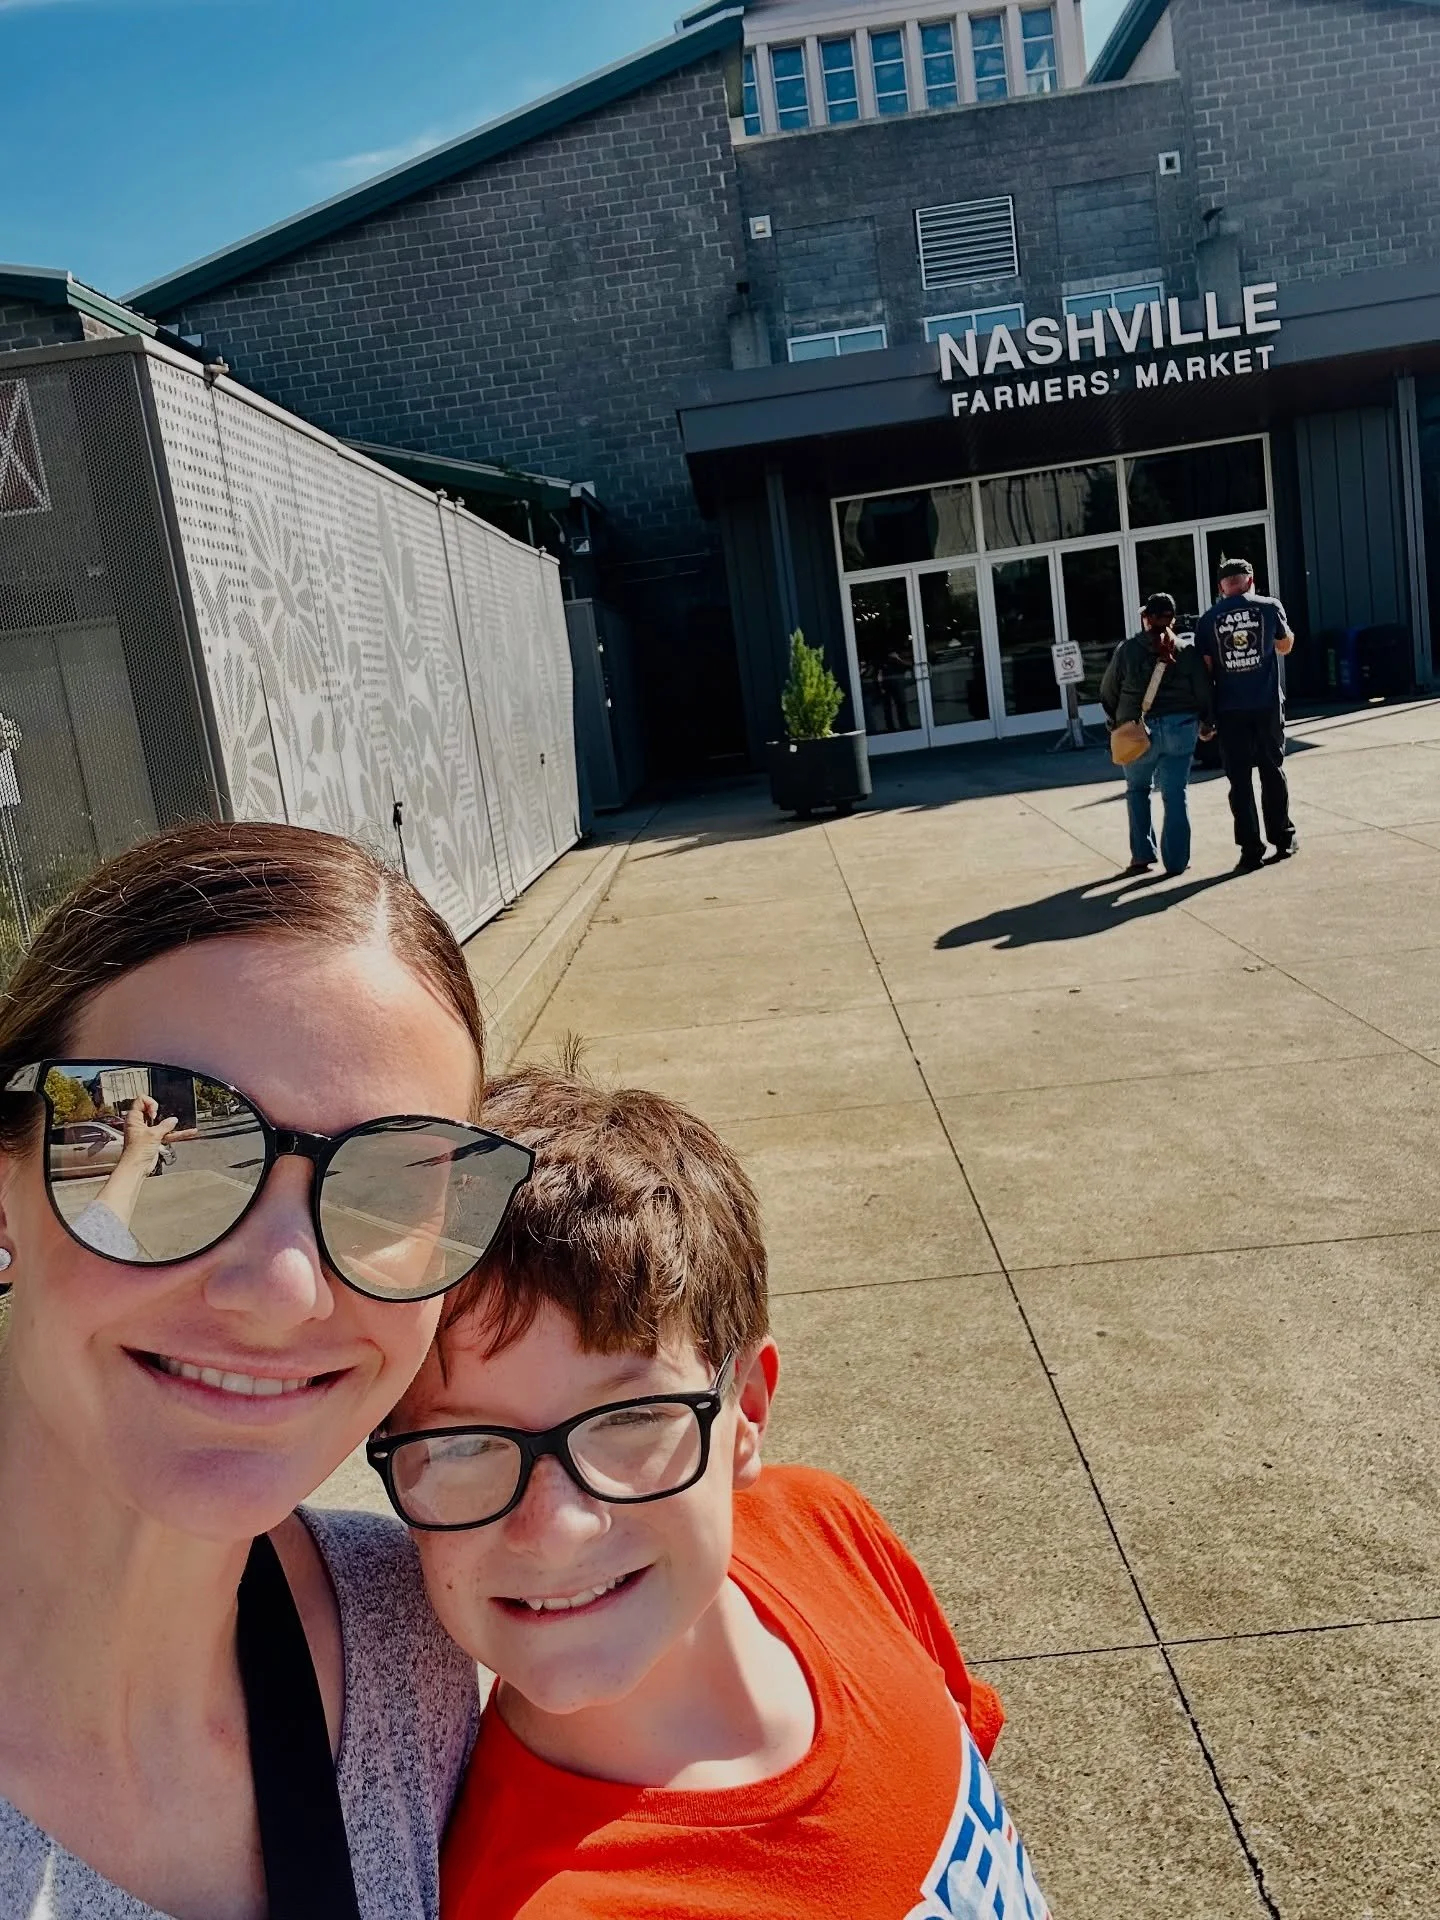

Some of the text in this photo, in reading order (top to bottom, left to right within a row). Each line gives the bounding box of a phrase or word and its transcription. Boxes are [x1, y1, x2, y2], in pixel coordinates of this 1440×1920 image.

[937, 281, 1282, 382] NASHVILLE
[952, 345, 1275, 417] FARMERS' MARKET
[1225, 611, 1250, 624] AGE
[1225, 655, 1261, 669] WHISKEY
